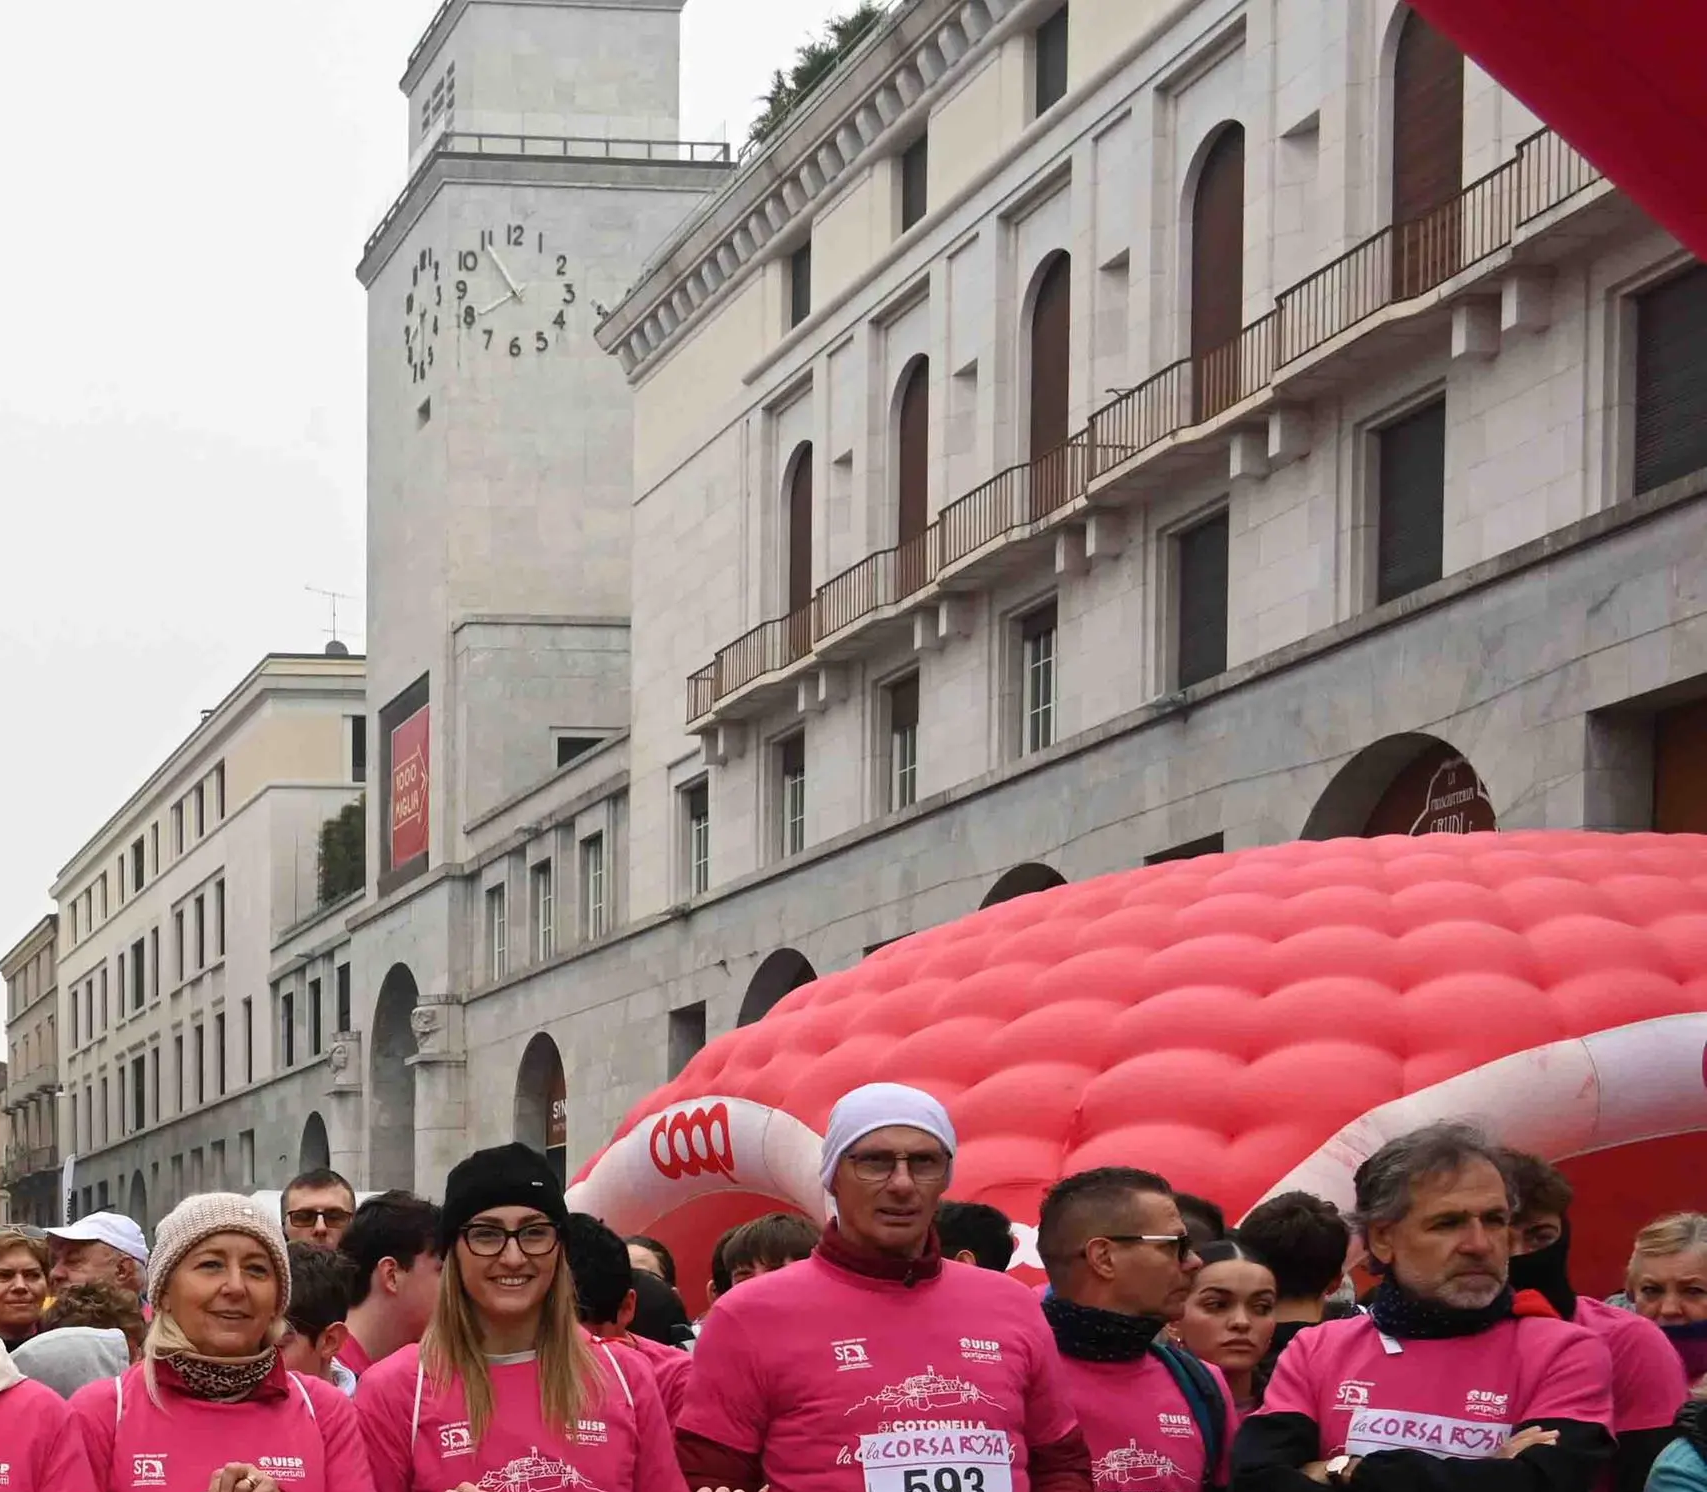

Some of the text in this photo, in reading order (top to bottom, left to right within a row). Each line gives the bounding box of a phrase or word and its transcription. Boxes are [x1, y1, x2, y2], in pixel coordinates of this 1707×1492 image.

[481, 230, 493, 251] 11
[507, 224, 524, 246] 12
[539, 232, 543, 253] 1
[459, 251, 478, 271] 10
[556, 255, 568, 276] 2
[456, 280, 467, 300] 9
[563, 284, 575, 304] 3
[463, 305, 475, 326] 8
[553, 310, 565, 329] 4
[483, 329, 493, 350] 7
[509, 337, 521, 357] 6
[536, 332, 548, 351] 5
[396, 764, 416, 791] 1000
[396, 790, 419, 823] MIGLIA
[971, 1340, 1000, 1350] UISP
[577, 1420, 606, 1432] UISP
[893, 1420, 987, 1432] COTONELLA
[1353, 1415, 1365, 1433] la
[1369, 1418, 1442, 1445] CORSA
[836, 1445, 852, 1465] la
[866, 1440, 880, 1460] la
[882, 1436, 955, 1459] CORSA
[274, 1456, 304, 1467] UISP
